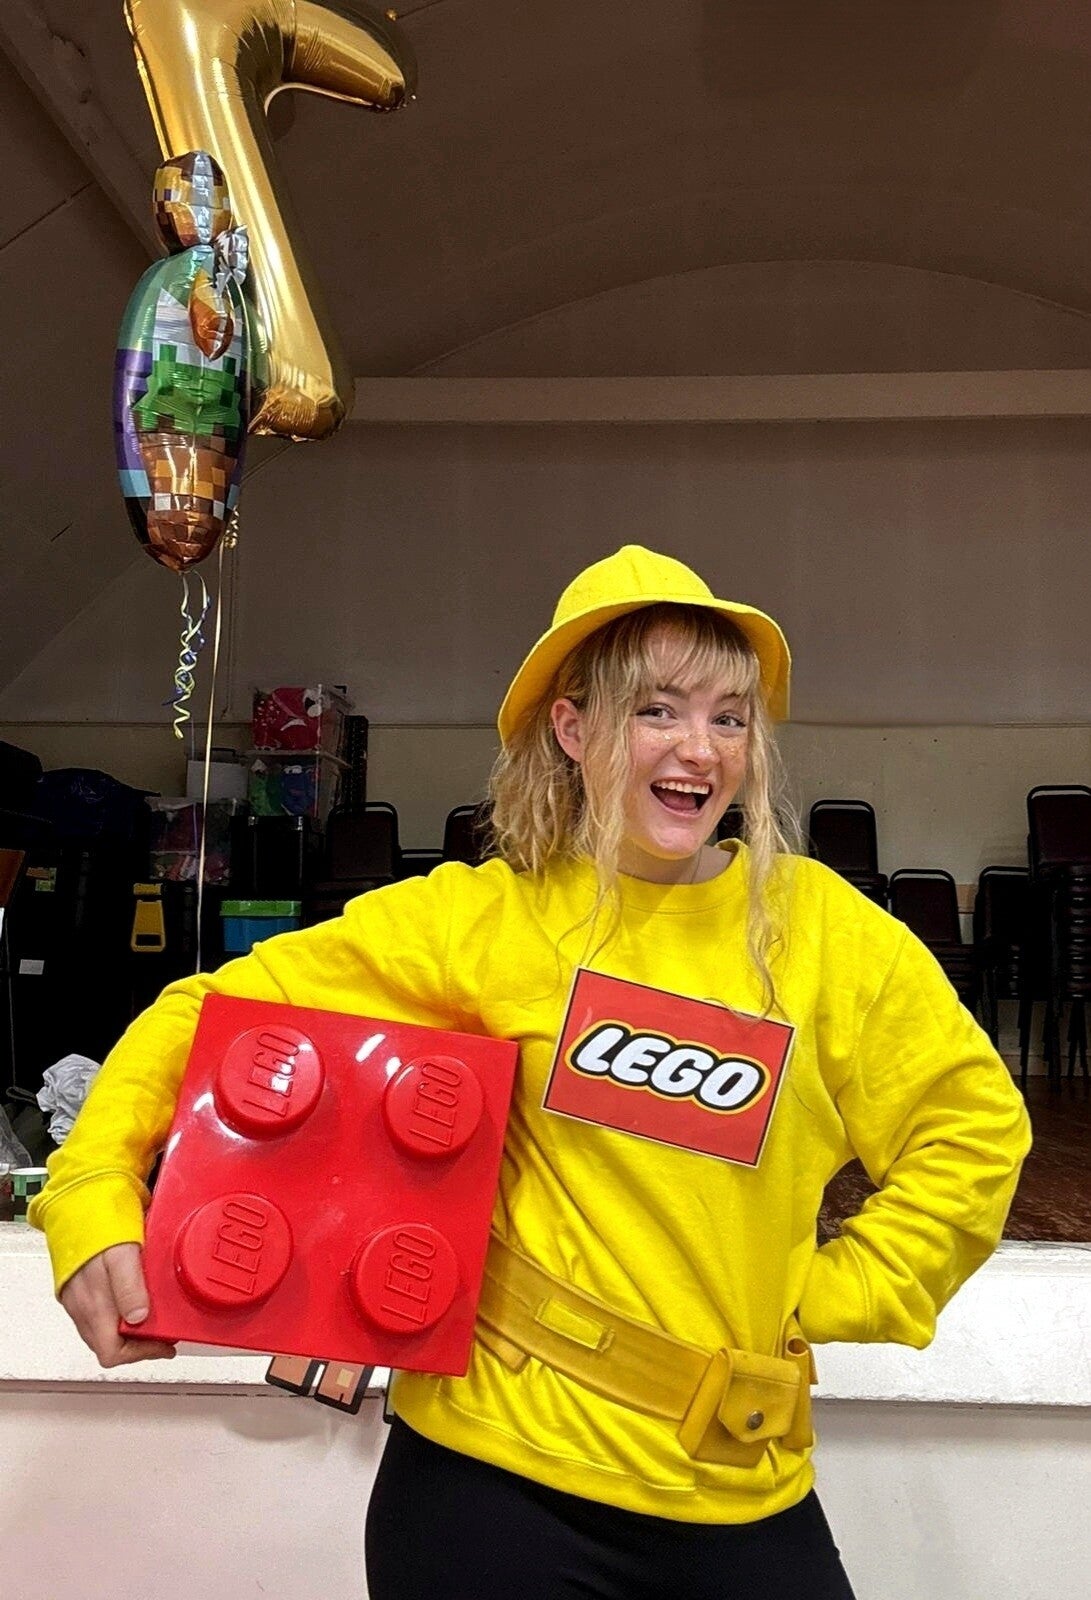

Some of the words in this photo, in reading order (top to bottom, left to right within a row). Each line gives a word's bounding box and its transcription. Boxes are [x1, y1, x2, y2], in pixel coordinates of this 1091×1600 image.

[243, 1031, 301, 1118] LEGO
[409, 1061, 464, 1148] LEGO
[571, 1023, 766, 1110] LEGO
[206, 1201, 268, 1296] LEGO
[380, 1231, 438, 1324] LEGO
